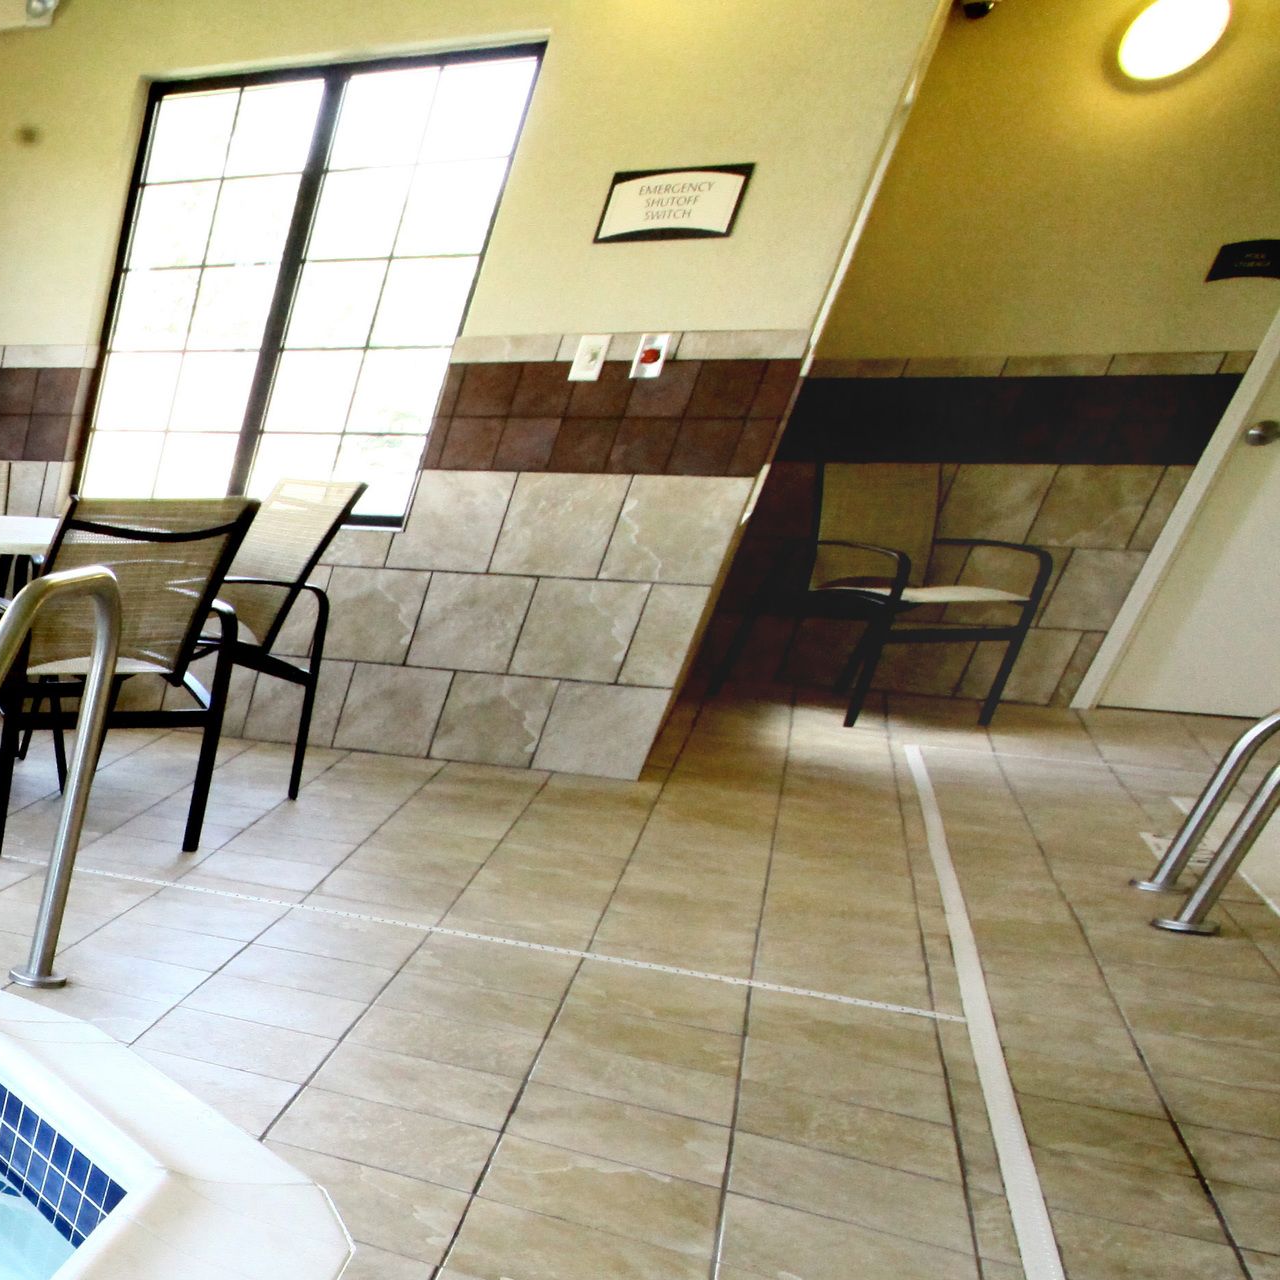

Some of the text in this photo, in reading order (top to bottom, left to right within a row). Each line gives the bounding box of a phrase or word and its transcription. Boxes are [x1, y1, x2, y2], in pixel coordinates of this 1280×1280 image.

[639, 181, 716, 195] EMERGENCY
[644, 195, 700, 208] SHUTOFF
[644, 208, 692, 221] SWITCH
